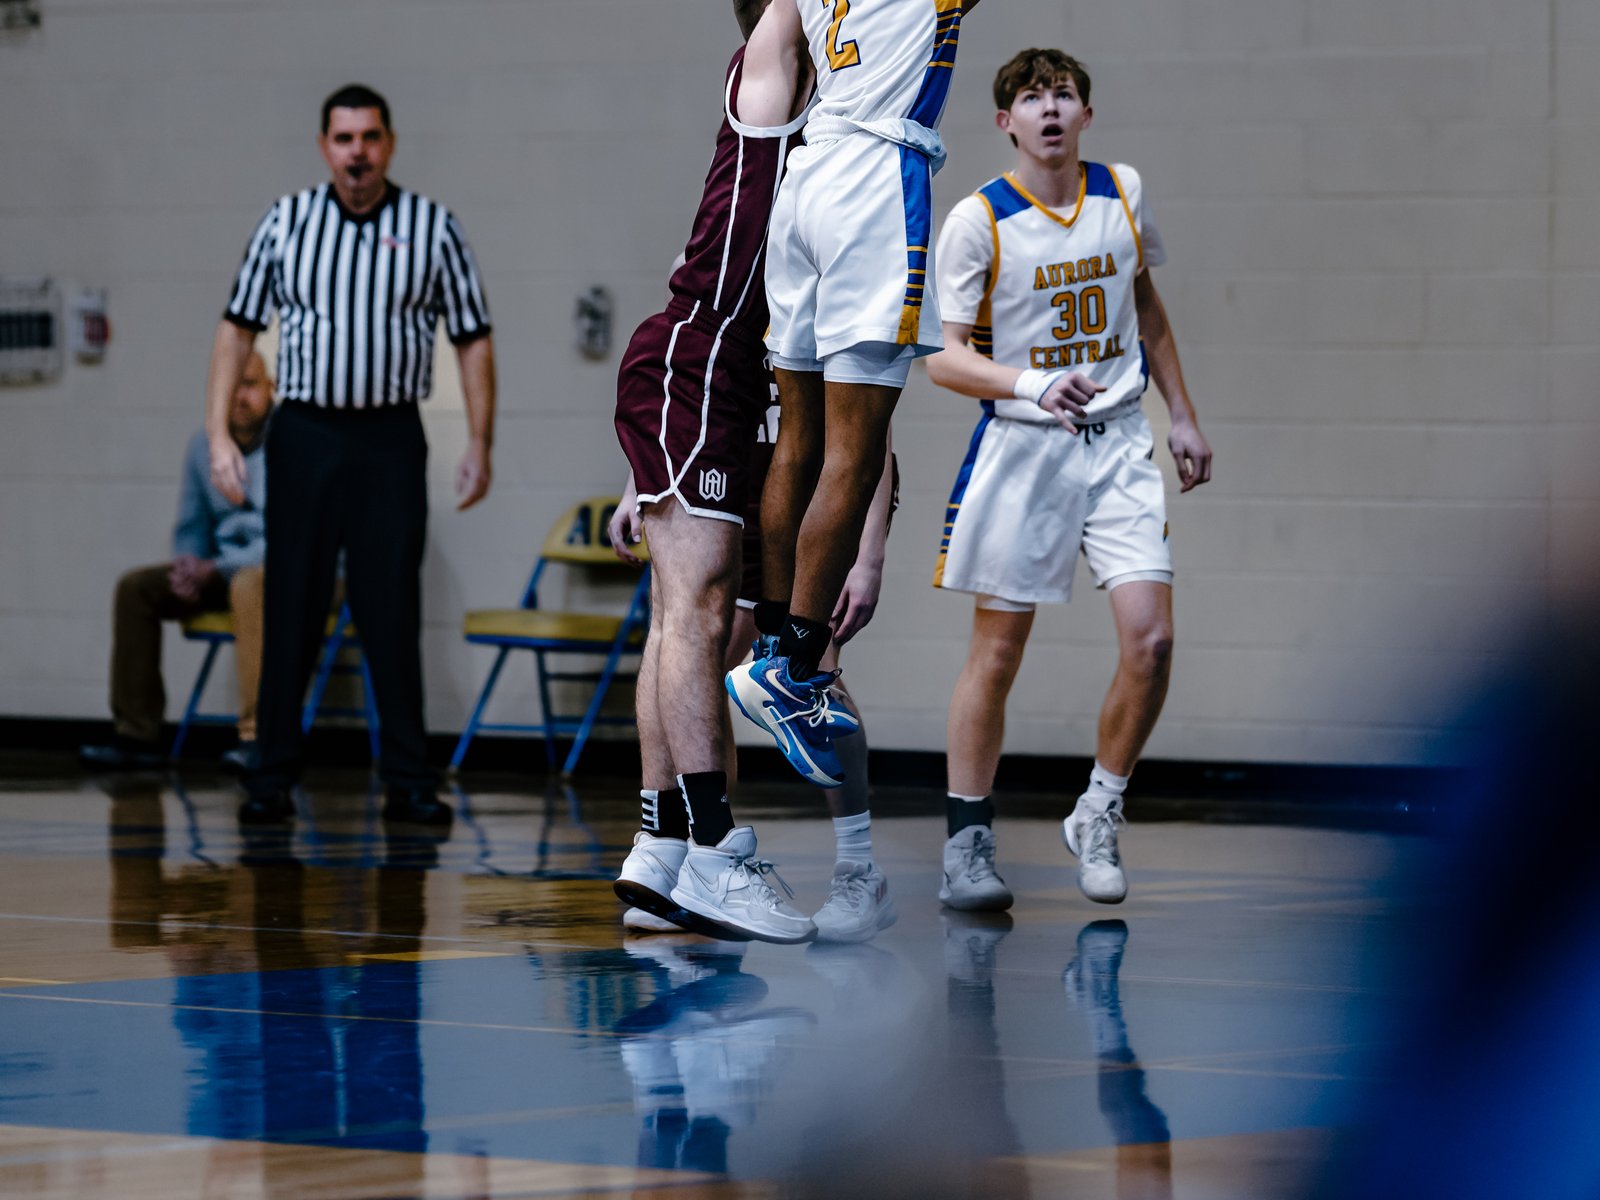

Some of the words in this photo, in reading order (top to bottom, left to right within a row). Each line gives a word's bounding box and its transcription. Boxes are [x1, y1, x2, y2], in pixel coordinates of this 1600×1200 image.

[1033, 253, 1118, 290] AURORA
[1051, 286, 1107, 340] 30
[1030, 335, 1125, 369] CENTRAL
